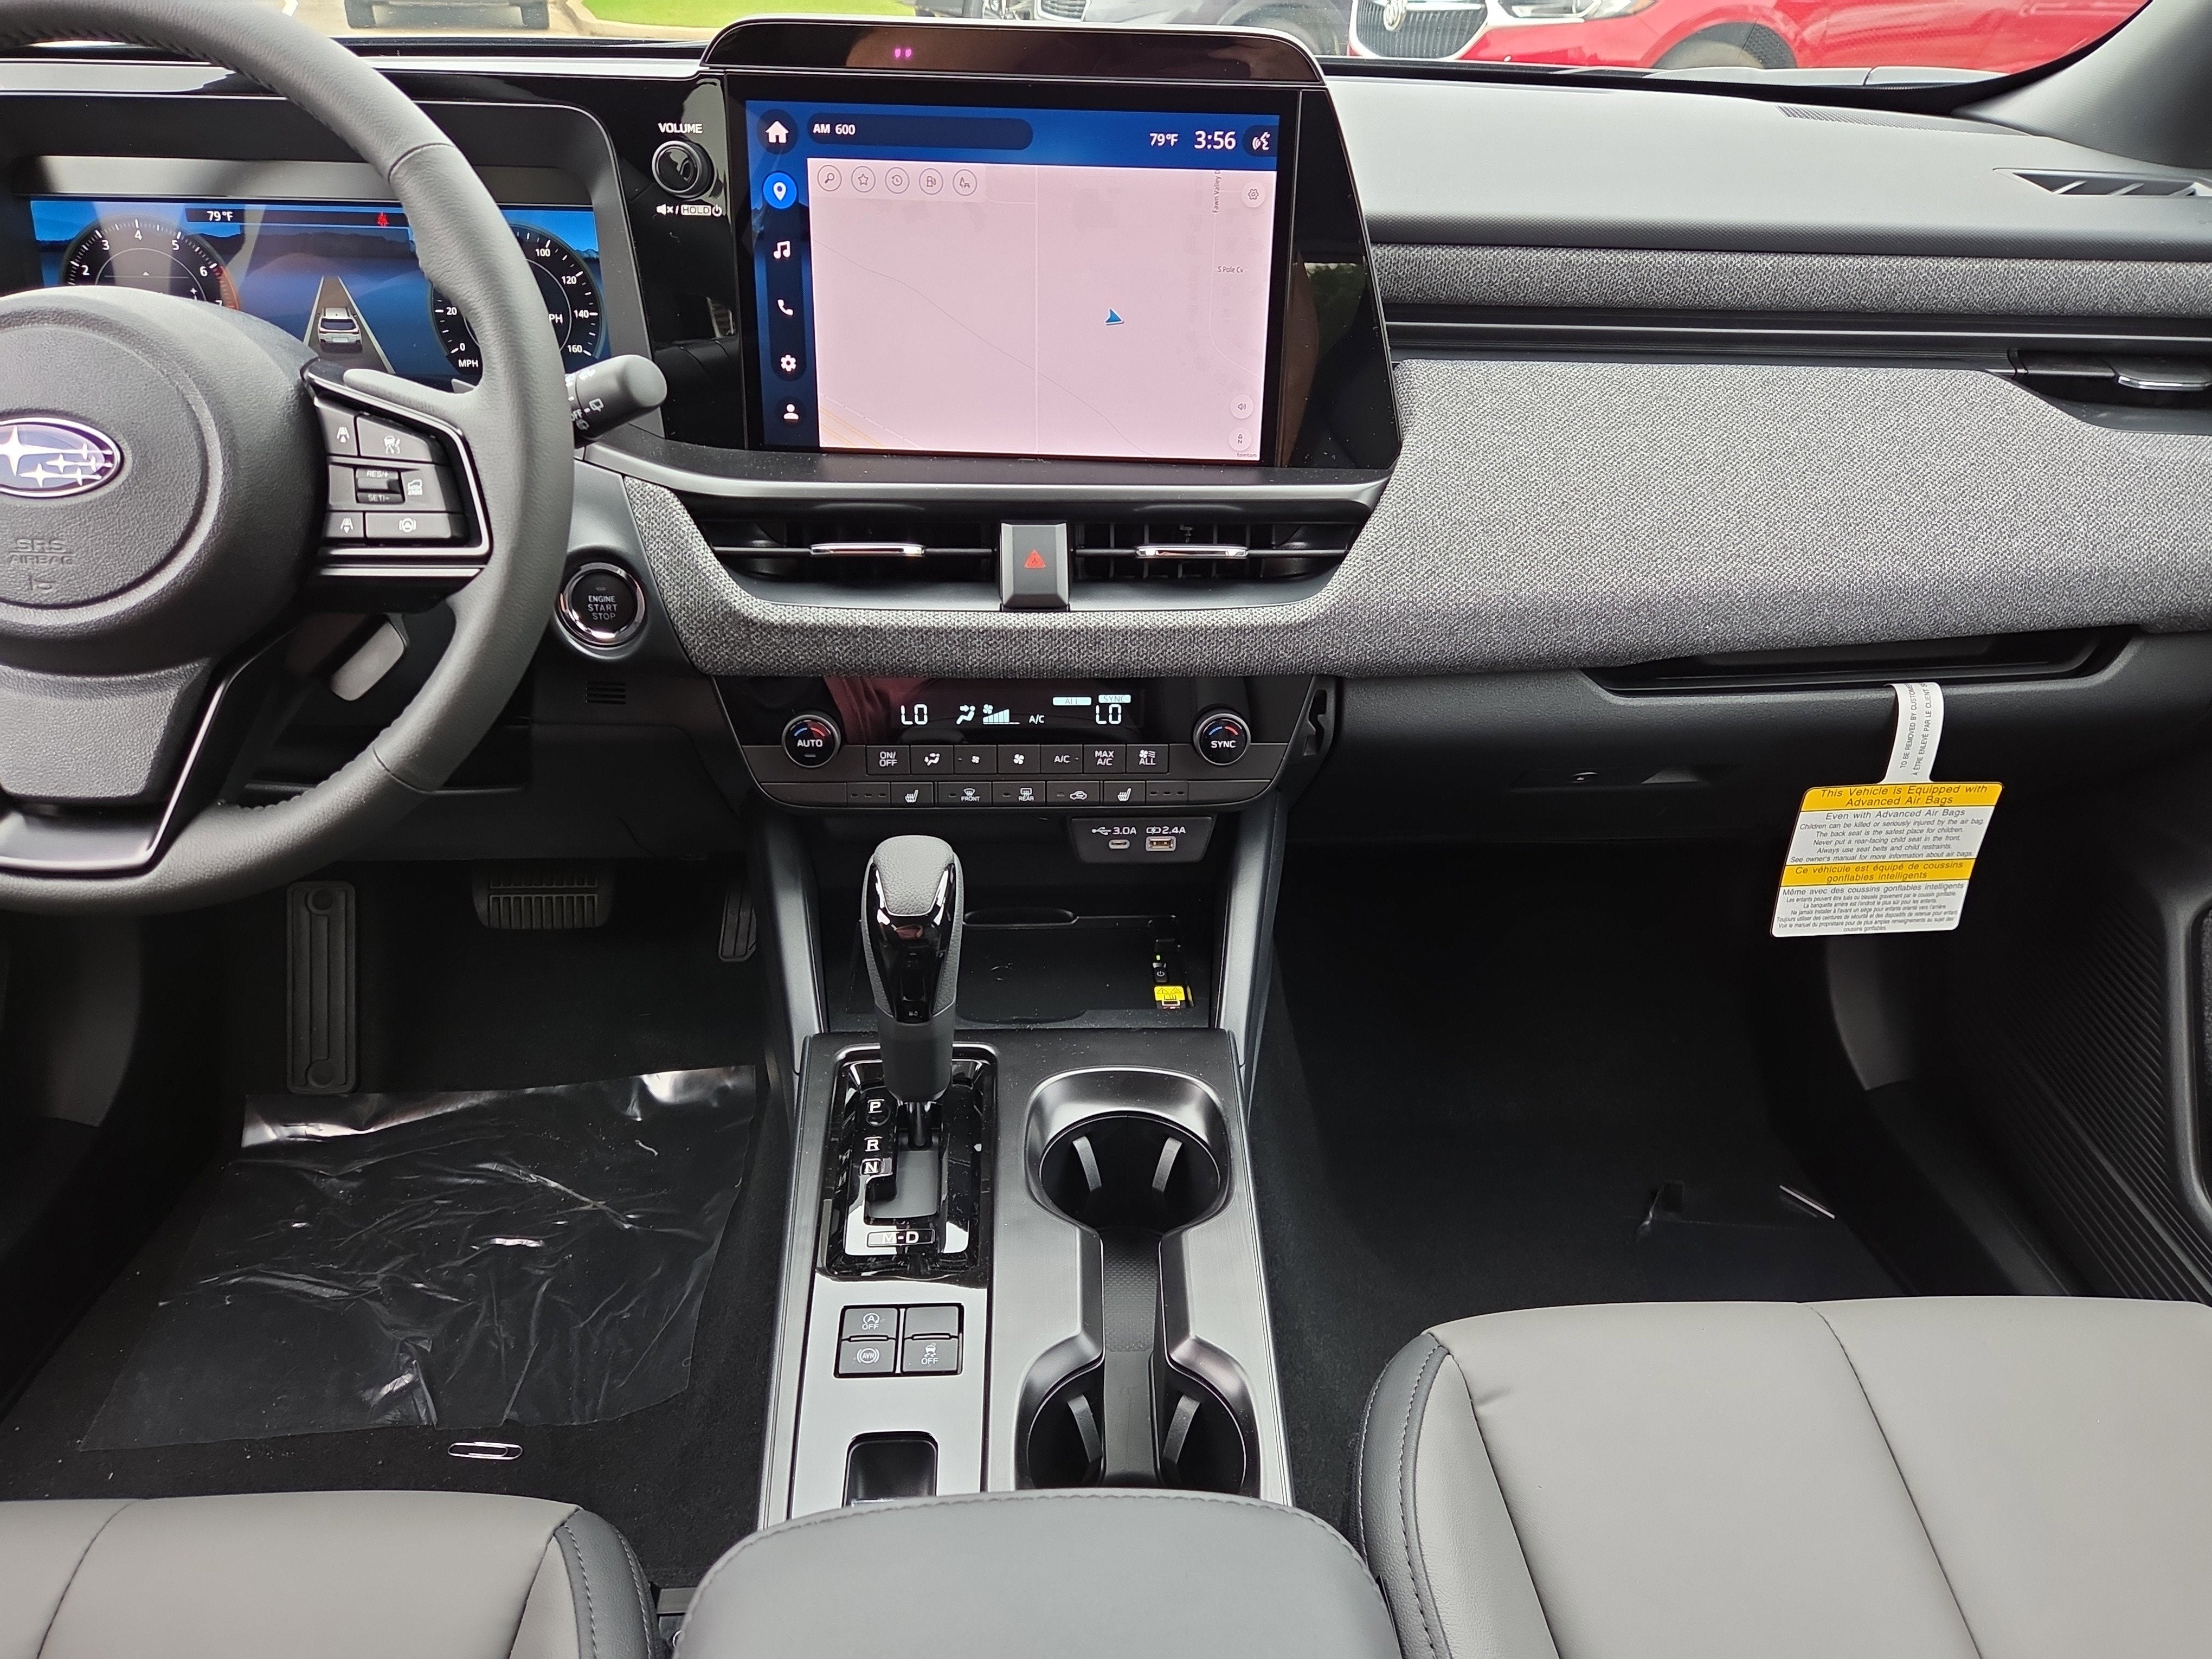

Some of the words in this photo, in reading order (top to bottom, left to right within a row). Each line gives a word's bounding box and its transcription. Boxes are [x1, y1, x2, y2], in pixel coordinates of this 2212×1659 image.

[658, 123, 704, 134] VOLUME
[813, 124, 831, 134] AM
[835, 124, 856, 136] 600
[1149, 132, 1179, 147] 79°F
[1194, 130, 1237, 150] 3:56
[1213, 176, 1222, 195] Valley
[207, 210, 234, 222] 79°F
[134, 229, 143, 241] 4
[102, 240, 111, 250] 3
[172, 239, 180, 250] 5
[535, 248, 551, 258] 100
[82, 265, 90, 276] 2
[200, 266, 208, 278] 6
[561, 275, 577, 285] 120
[446, 307, 458, 316] 20
[573, 310, 590, 319] 140
[549, 313, 563, 324] PH
[459, 343, 466, 352] 0
[567, 344, 583, 353] 160
[458, 359, 479, 369] MPH
[15, 538, 66, 552] SRS
[9, 555, 75, 564] AIRBAG
[587, 603, 618, 612] START
[1905, 683, 1917, 710] CUSTOME
[1923, 689, 1932, 709] CLIENT
[1029, 715, 1045, 724] A/C
[1910, 712, 1917, 721] BY
[1905, 722, 1916, 750] REMOVED
[796, 738, 824, 748] AUTO
[1211, 740, 1237, 749] SYNC
[879, 751, 897, 761] ON/
[1054, 755, 1070, 764] A/C
[879, 759, 898, 767] OFF
[1096, 757, 1114, 767] A/C
[1900, 761, 1907, 769] TO
[1821, 789, 1843, 798] This
[1849, 786, 1888, 796] Vehicle
[1893, 786, 1902, 794] is
[1907, 785, 1961, 796] Equipped
[1965, 785, 1988, 793] with
[1845, 796, 1901, 807] Advanced
[1905, 796, 1921, 805] Air
[1925, 795, 1954, 806] Bags
[1825, 812, 1849, 820] Even
[1875, 809, 1922, 818] Advanced
[1941, 809, 1966, 818] Bags
[1913, 819, 1935, 827] injured
[1113, 826, 1137, 835] 3.0A
[1162, 826, 1186, 835] 2.4A
[1906, 827, 1925, 835] place
[1812, 865, 1851, 873] véhicule
[1873, 863, 1903, 872] équipé
[1907, 862, 1919, 870] de
[1923, 861, 1964, 870] coussins
[1826, 873, 1875, 884] gonflables
[1878, 871, 1928, 882] intelligents
[1783, 888, 1806, 896] Même
[1847, 884, 1881, 893] coussins
[1883, 884, 1922, 893] gonflables
[1925, 882, 1965, 891] intelligents
[869, 1101, 882, 1111] P
[867, 1139, 880, 1151] R
[863, 1161, 879, 1174] N
